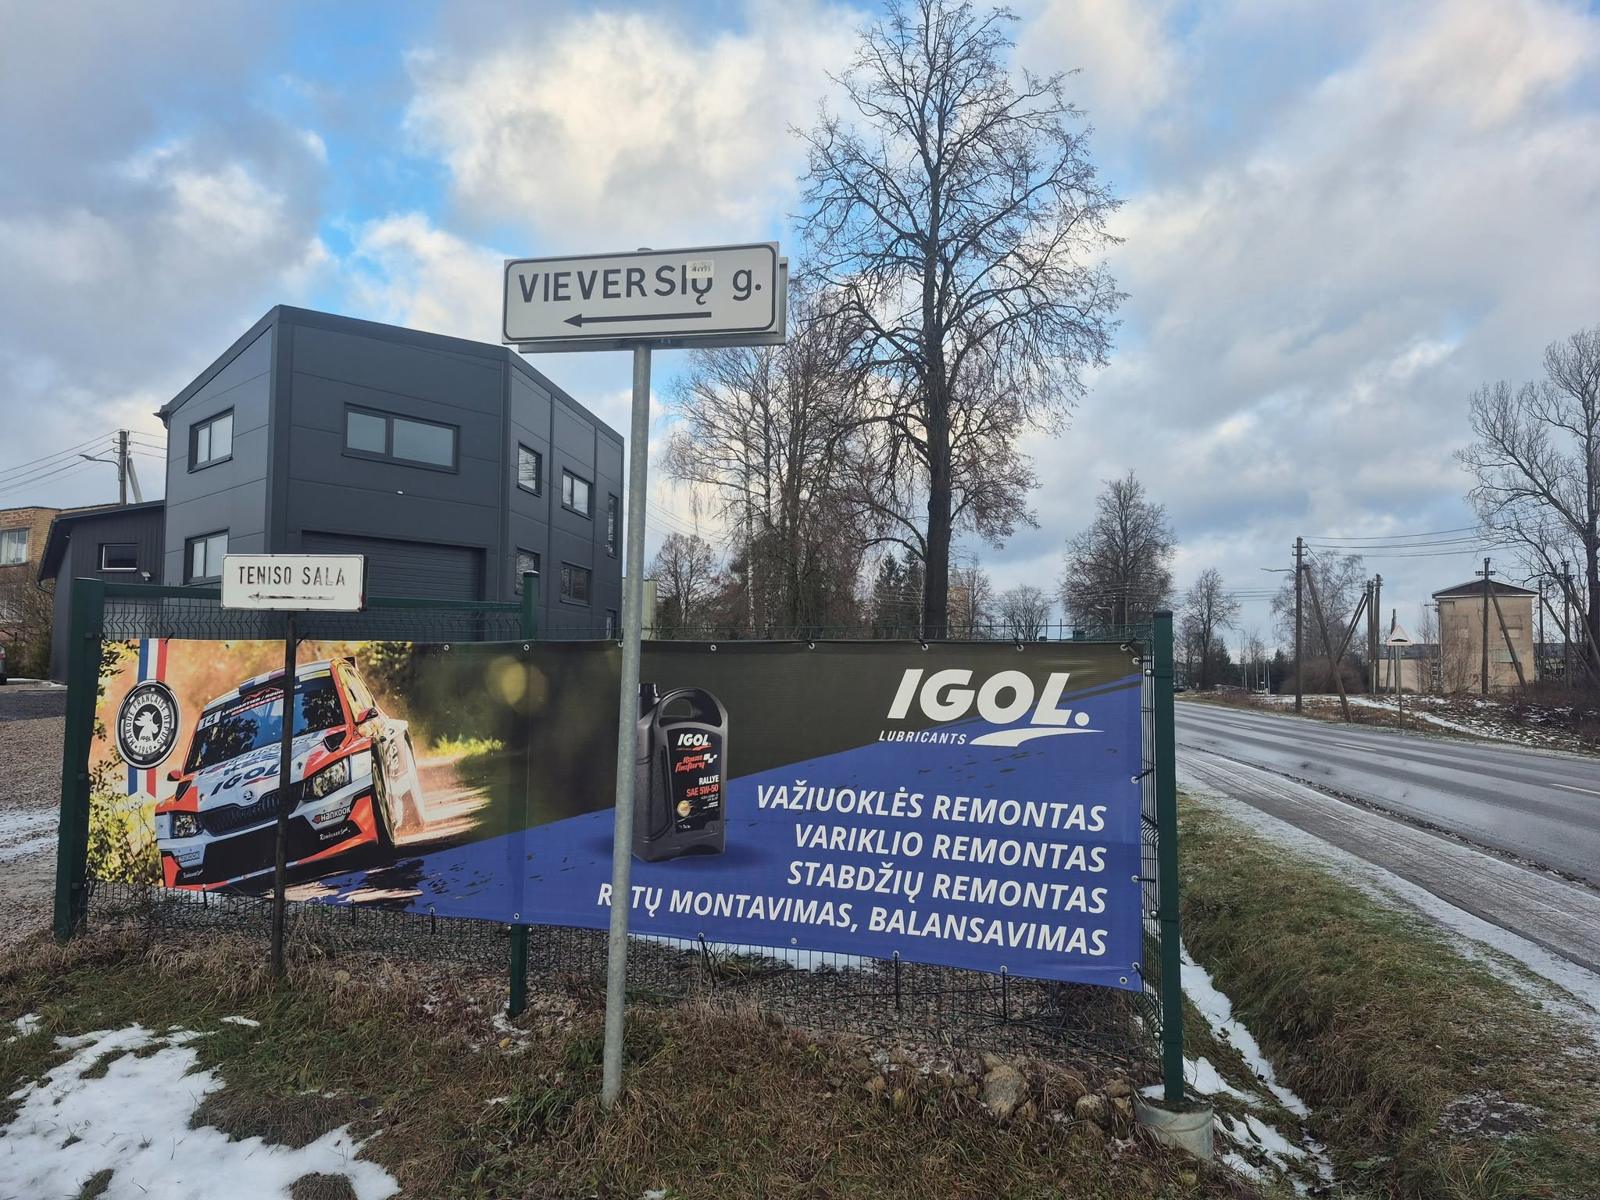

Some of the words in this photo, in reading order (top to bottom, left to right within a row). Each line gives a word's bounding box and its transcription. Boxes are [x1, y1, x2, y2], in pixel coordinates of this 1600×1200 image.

[518, 264, 713, 305] VIEVERSIŲ
[732, 269, 762, 301] g.
[239, 566, 292, 585] TENISO
[302, 566, 346, 586] SALA
[202, 716, 216, 728] 14
[878, 730, 967, 745] LUBRICANTS
[686, 786, 699, 797] SAE
[699, 774, 719, 786] RALLYE
[757, 779, 924, 819] VAŽIUOKLĖS
[932, 794, 1107, 832] REMONTAS
[794, 823, 923, 857] VARIKLIO
[932, 835, 1107, 873] REMONTAS
[787, 861, 924, 903] STABDŽIŲ
[932, 873, 1108, 914] REMONTAS
[597, 883, 663, 917] RTŲ
[669, 889, 859, 933] MONTAVIMAS,
[868, 906, 1108, 957] BALANSAVIMAS
